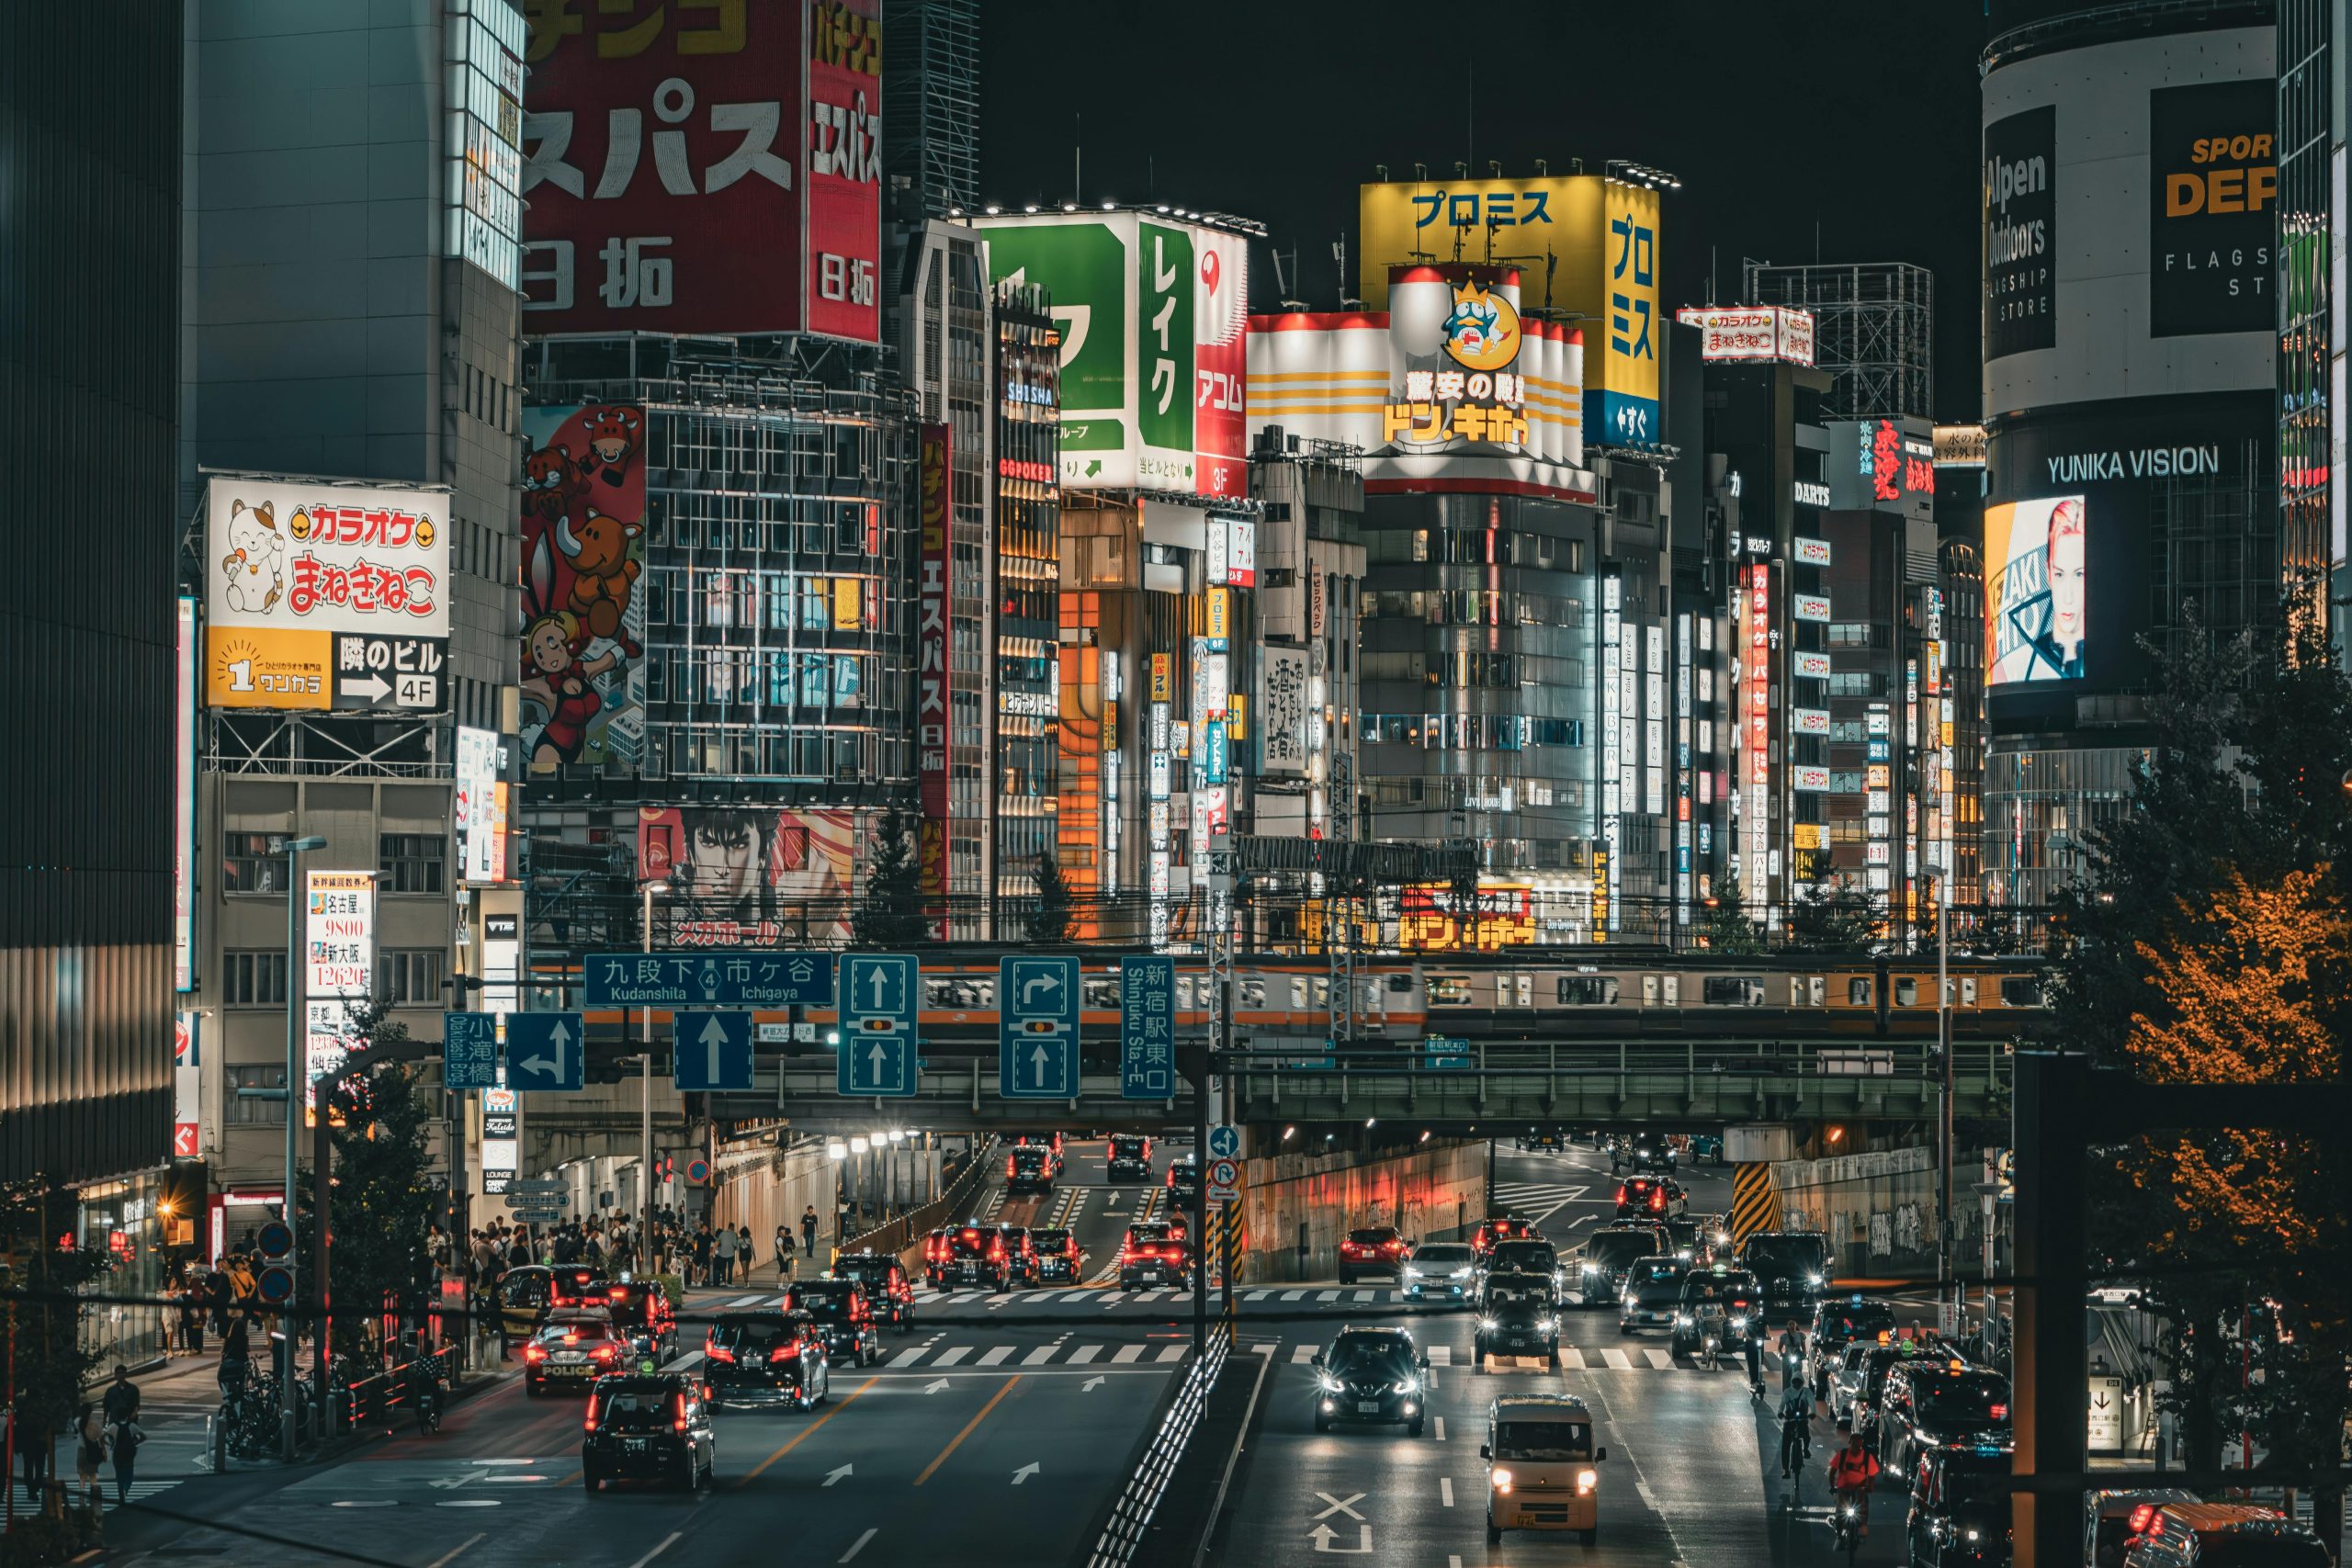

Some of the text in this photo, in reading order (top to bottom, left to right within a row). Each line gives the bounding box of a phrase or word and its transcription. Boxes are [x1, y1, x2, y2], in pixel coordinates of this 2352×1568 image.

[814, 3, 881, 76] パチンコ
[809, 90, 881, 184] エスパス
[2191, 134, 2277, 164] SPOR
[1985, 155, 2045, 214] Alpen
[2166, 167, 2277, 217] DEP
[1412, 190, 1553, 229] プロミス
[1989, 215, 2044, 268] Outdoors
[2166, 248, 2267, 271] FLAGS
[821, 253, 874, 306] 日拓
[1986, 268, 2046, 299] FLAGSHIP
[1718, 316, 1763, 328] カラオケ
[2001, 297, 2046, 321] STORE
[1152, 235, 1176, 415] レイク
[1709, 333, 1770, 351] まねきねこ
[1008, 382, 1052, 405] SHISHA
[1198, 370, 1242, 412] アコム
[1407, 371, 1525, 403] 驚安の殿堂
[1058, 425, 1089, 439] ループ
[1626, 409, 1646, 438] すぐ
[1000, 458, 1052, 481] GGPOKER
[1139, 458, 1183, 478] 当ビルとなり
[2048, 446, 2219, 483] YUNIKA VISION
[1213, 468, 1227, 491] 3F
[923, 440, 944, 551] パチンコ
[1794, 482, 1830, 506] DARTS
[310, 504, 415, 547] カラオケ
[1807, 545, 1825, 559] カラオケ
[289, 553, 435, 615] まねきねこ
[1214, 594, 1223, 633] プロミス
[1754, 575, 1767, 646] カラオケ
[1807, 602, 1825, 616] カラオケ
[266, 661, 322, 672] ひとりカラオケ専門店
[340, 637, 443, 673] 隣のビル
[1807, 659, 1825, 673] カラオケ
[259, 675, 322, 694] ワンカラ
[401, 680, 432, 702] 4F
[1806, 716, 1825, 730] カラオケ
[1213, 728, 1221, 775] セントラル
[1194, 767, 1207, 789] 7F
[1806, 772, 1825, 786] カラオケ
[328, 894, 357, 914] 名古屋
[325, 919, 363, 937] 9800
[328, 944, 359, 964] 新大阪
[317, 966, 363, 986] 12620
[604, 959, 694, 983] 九段下
[706, 974, 715, 987] 4
[611, 987, 798, 1000] Kudanshita Ichigaya
[1127, 967, 1144, 1031] Shinjuku
[450, 1016, 468, 1061] Otakibashi
[1145, 964, 1168, 1089] 新宿駅東口
[469, 1018, 493, 1083] 小滝橋
[543, 1366, 595, 1376] POLICE
